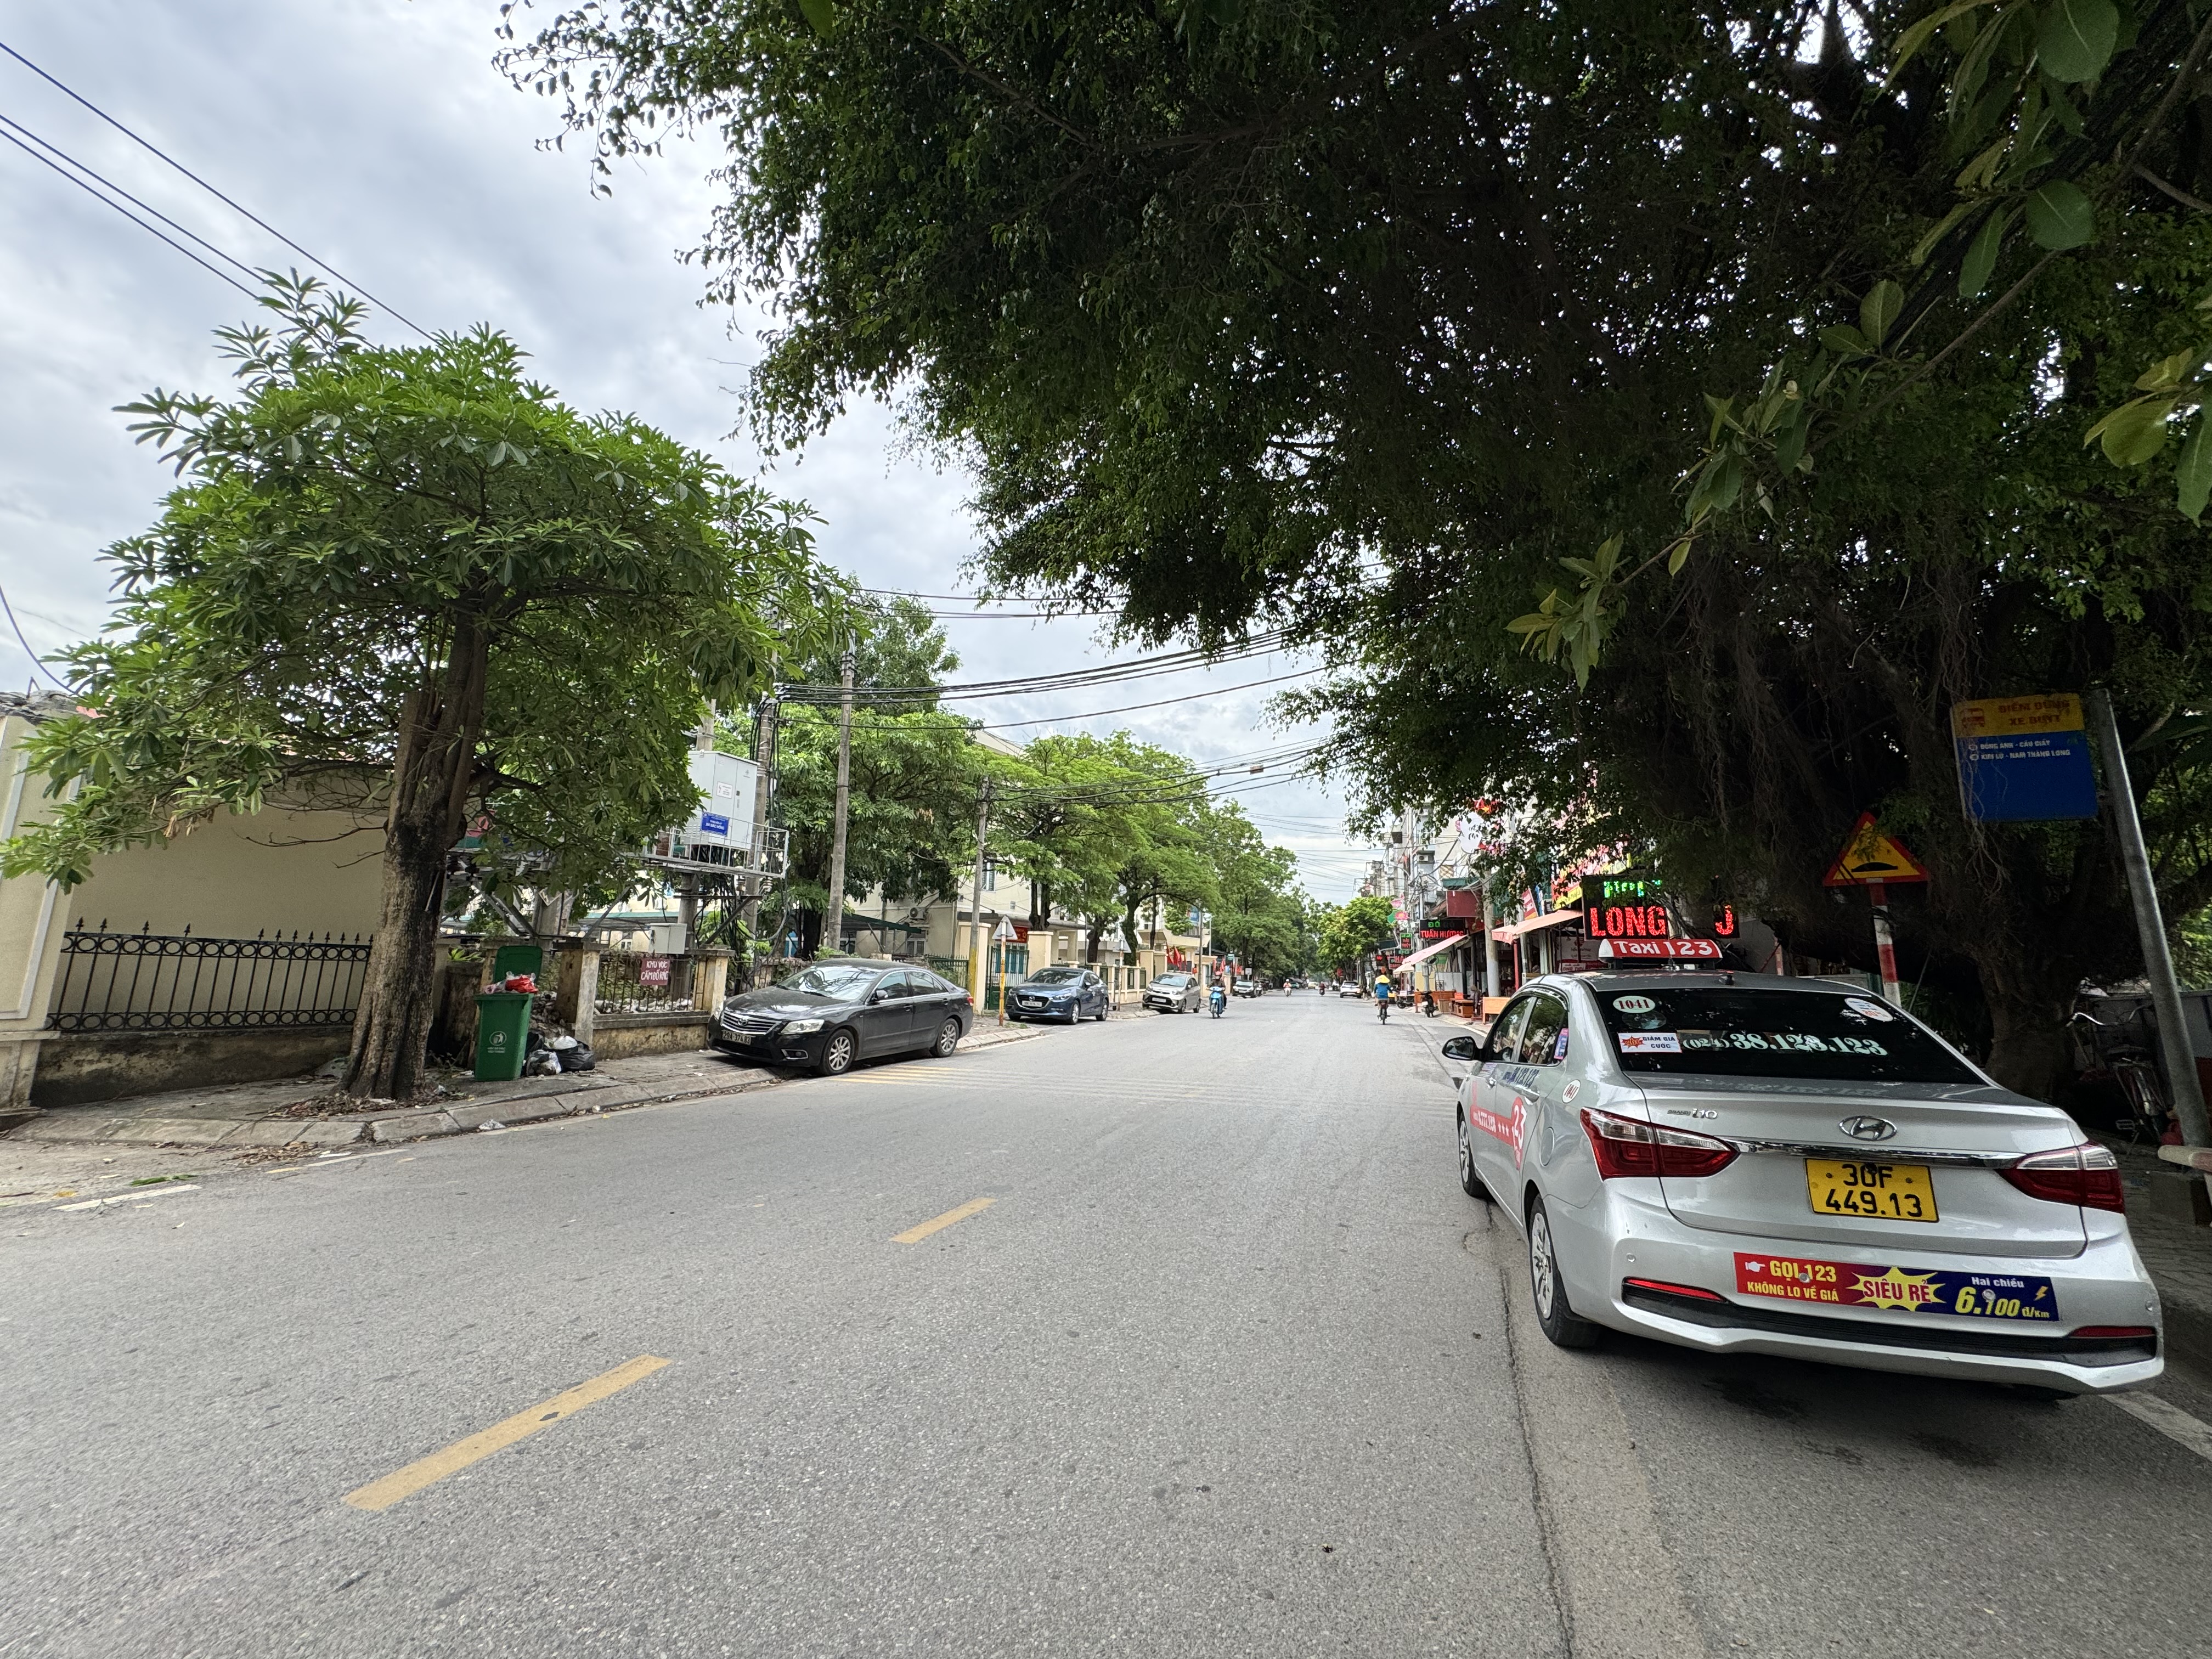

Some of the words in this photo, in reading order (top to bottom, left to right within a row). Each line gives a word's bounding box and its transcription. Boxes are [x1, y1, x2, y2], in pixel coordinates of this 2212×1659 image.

[1590, 906, 1666, 936] LONG
[1613, 941, 1661, 954] Taxi
[1663, 941, 1713, 956] 123
[1618, 999, 1651, 1010] 1041
[1841, 1163, 1893, 1188] 30F
[1825, 1188, 1923, 1217] 449.13
[1770, 1260, 1799, 1282] GỌI
[1804, 1264, 1837, 1283] 123
[1971, 1276, 1990, 1286] Hai
[1747, 1281, 1784, 1295] KHÔNG
[1787, 1285, 1801, 1297] LO
[1803, 1285, 1817, 1300] VỀ
[1820, 1287, 1839, 1301] GIÁ
[1863, 1278, 1903, 1300] SIÊU
[1909, 1279, 1932, 1304] RẺ
